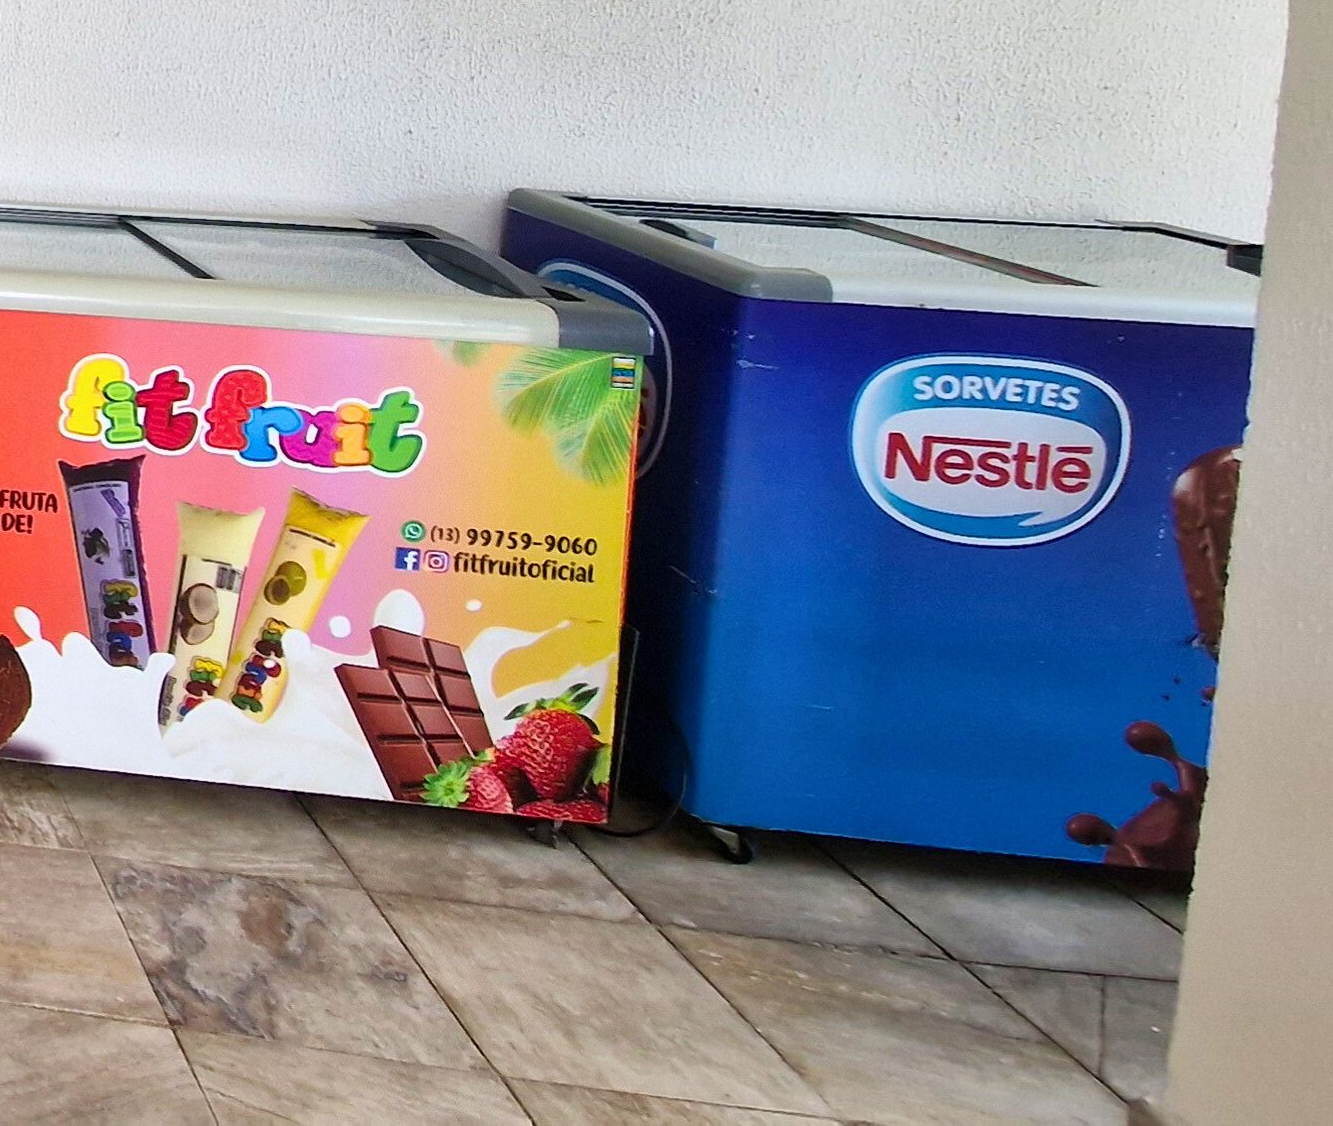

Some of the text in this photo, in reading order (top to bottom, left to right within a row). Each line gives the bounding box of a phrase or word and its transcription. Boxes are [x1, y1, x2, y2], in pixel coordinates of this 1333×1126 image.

[913, 375, 1081, 412] SORVETES
[66, 357, 424, 473] fit fruit
[430, 525, 598, 556] (13) 99759-9060
[453, 551, 595, 583] fitfruitoficial
